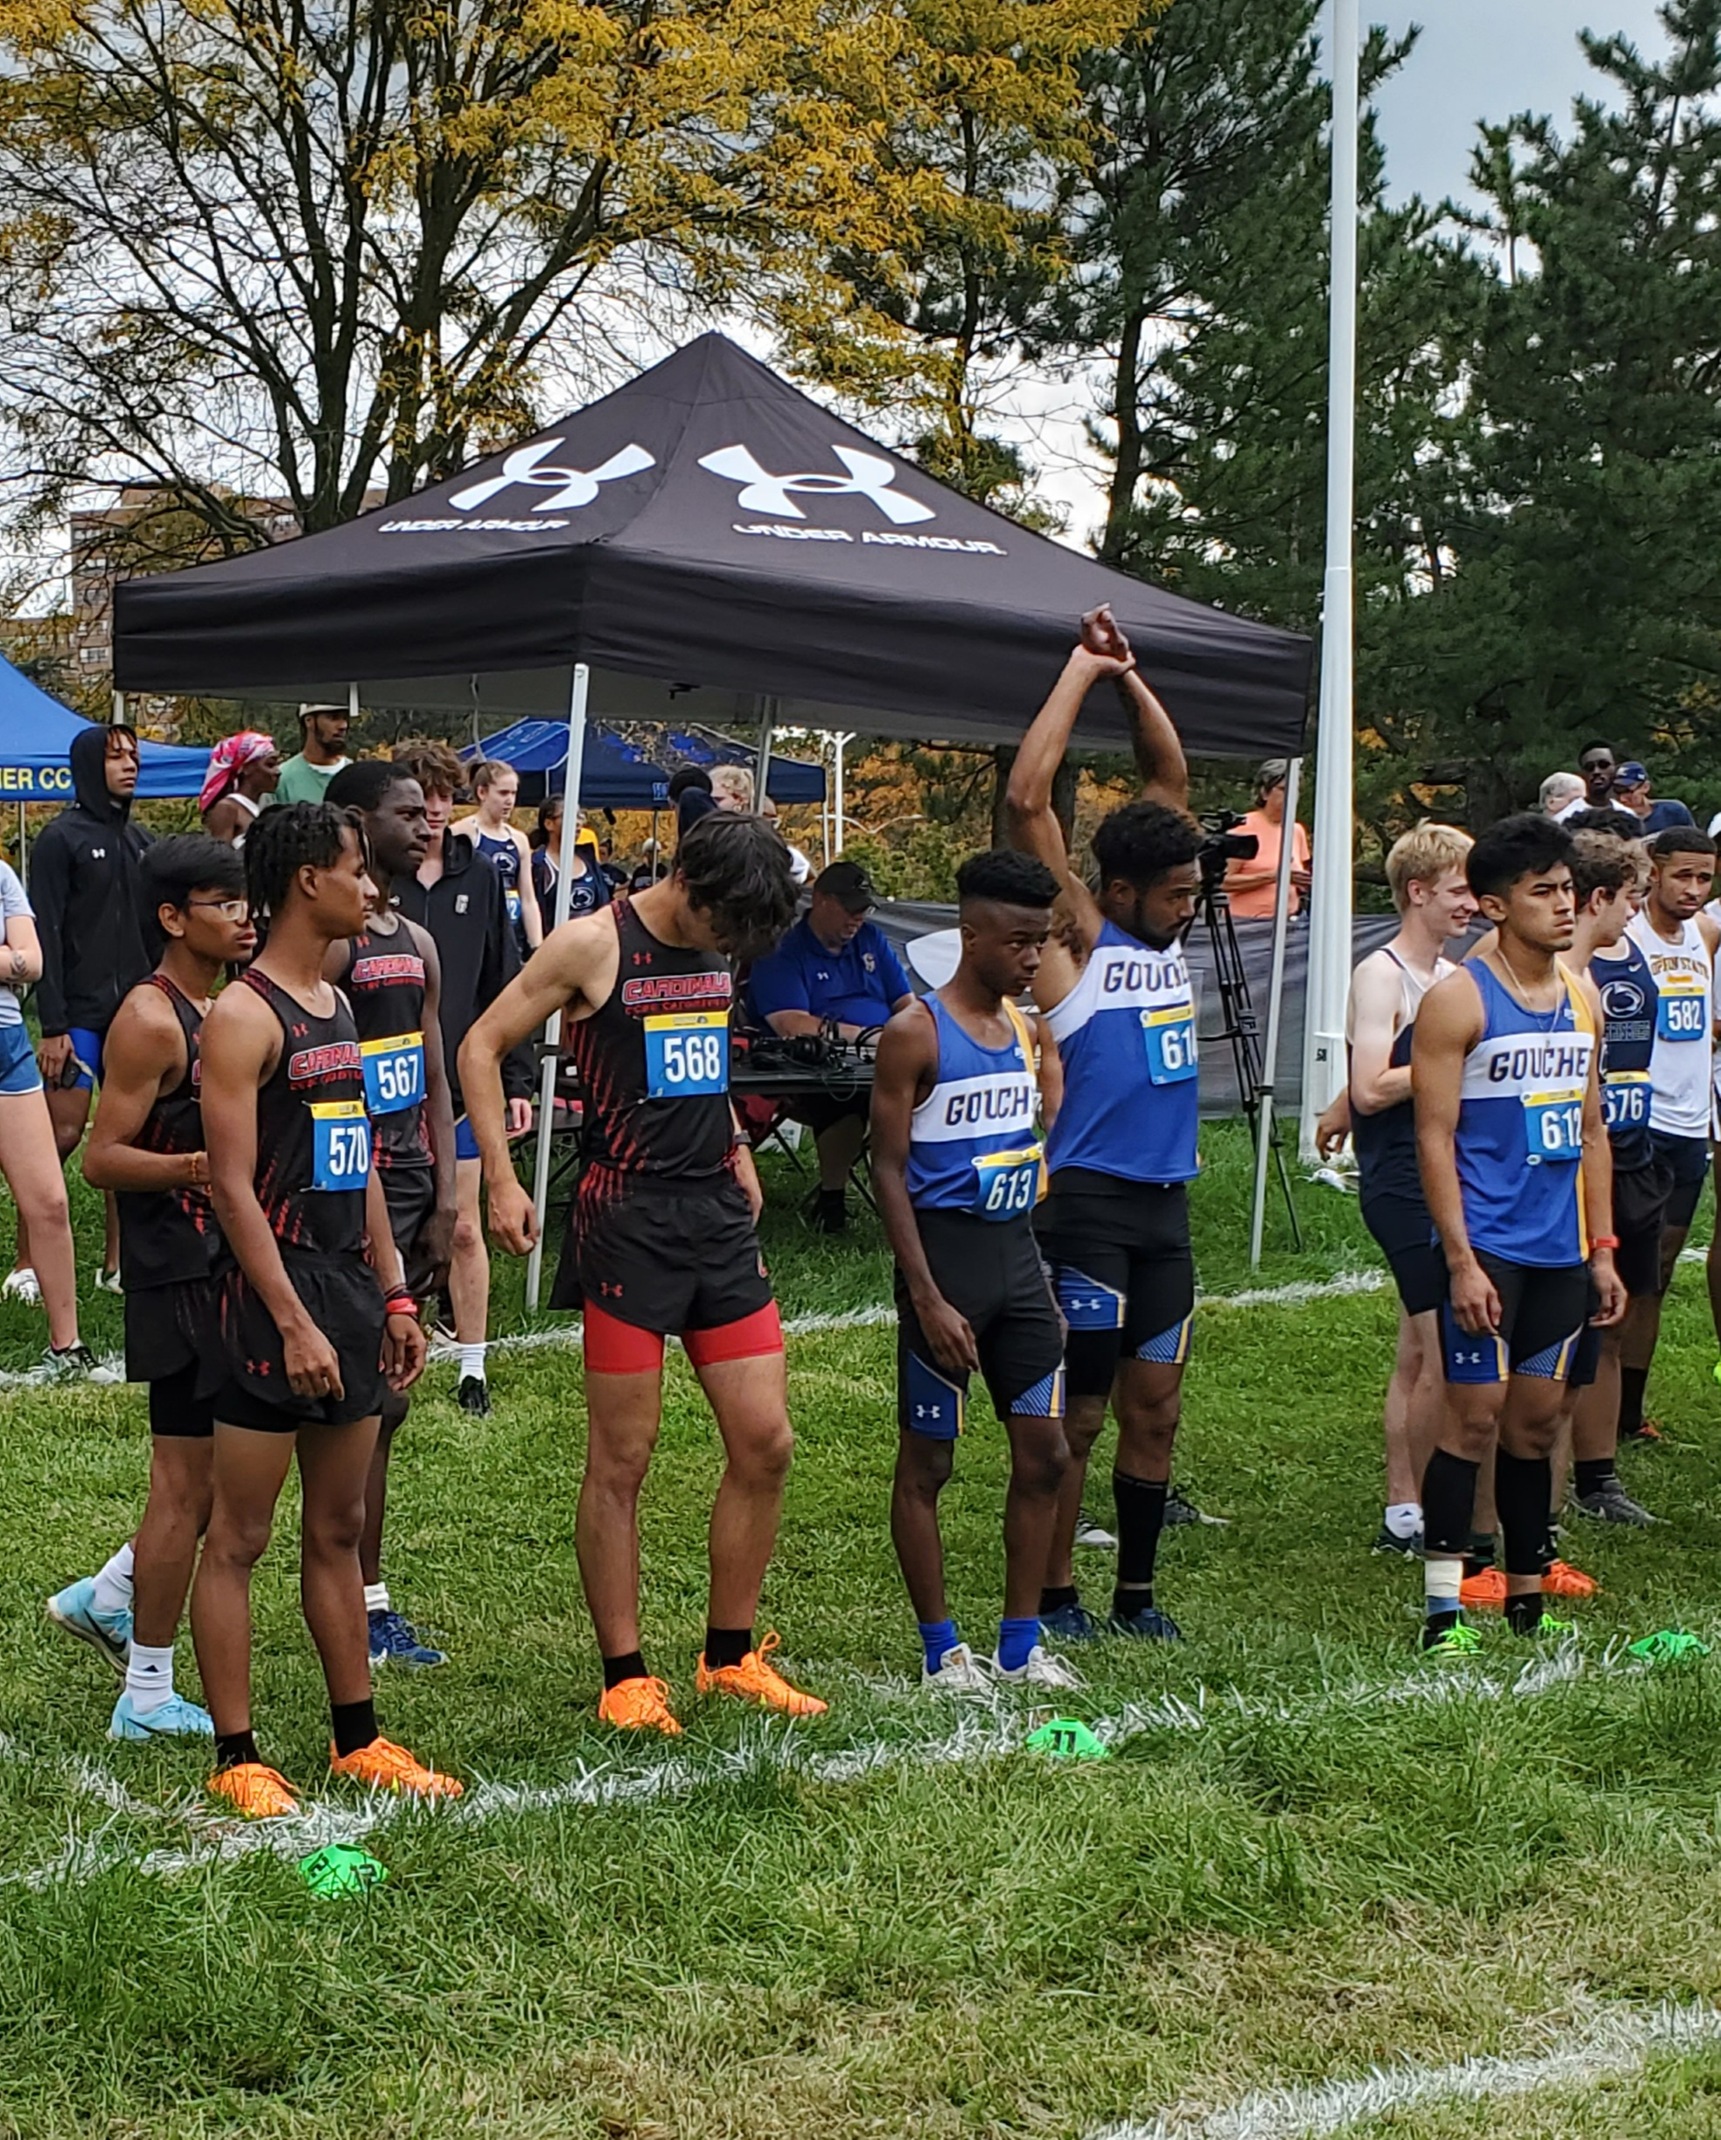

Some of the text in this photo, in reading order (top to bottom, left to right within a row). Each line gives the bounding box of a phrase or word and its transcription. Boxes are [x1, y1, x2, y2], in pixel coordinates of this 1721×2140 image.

[378, 519, 462, 532] UNDER
[732, 523, 1005, 556] UNDER ARMOUR
[0, 767, 34, 790] ER
[1667, 1000, 1702, 1031] 582
[663, 1035, 721, 1083] 568
[1161, 1024, 1198, 1070] 61
[1488, 1047, 1592, 1082] GOUCHE
[376, 1053, 420, 1100] 567
[329, 1125, 369, 1176] 570
[985, 1168, 1032, 1211] 613
[1050, 1729, 1077, 1754] 11
